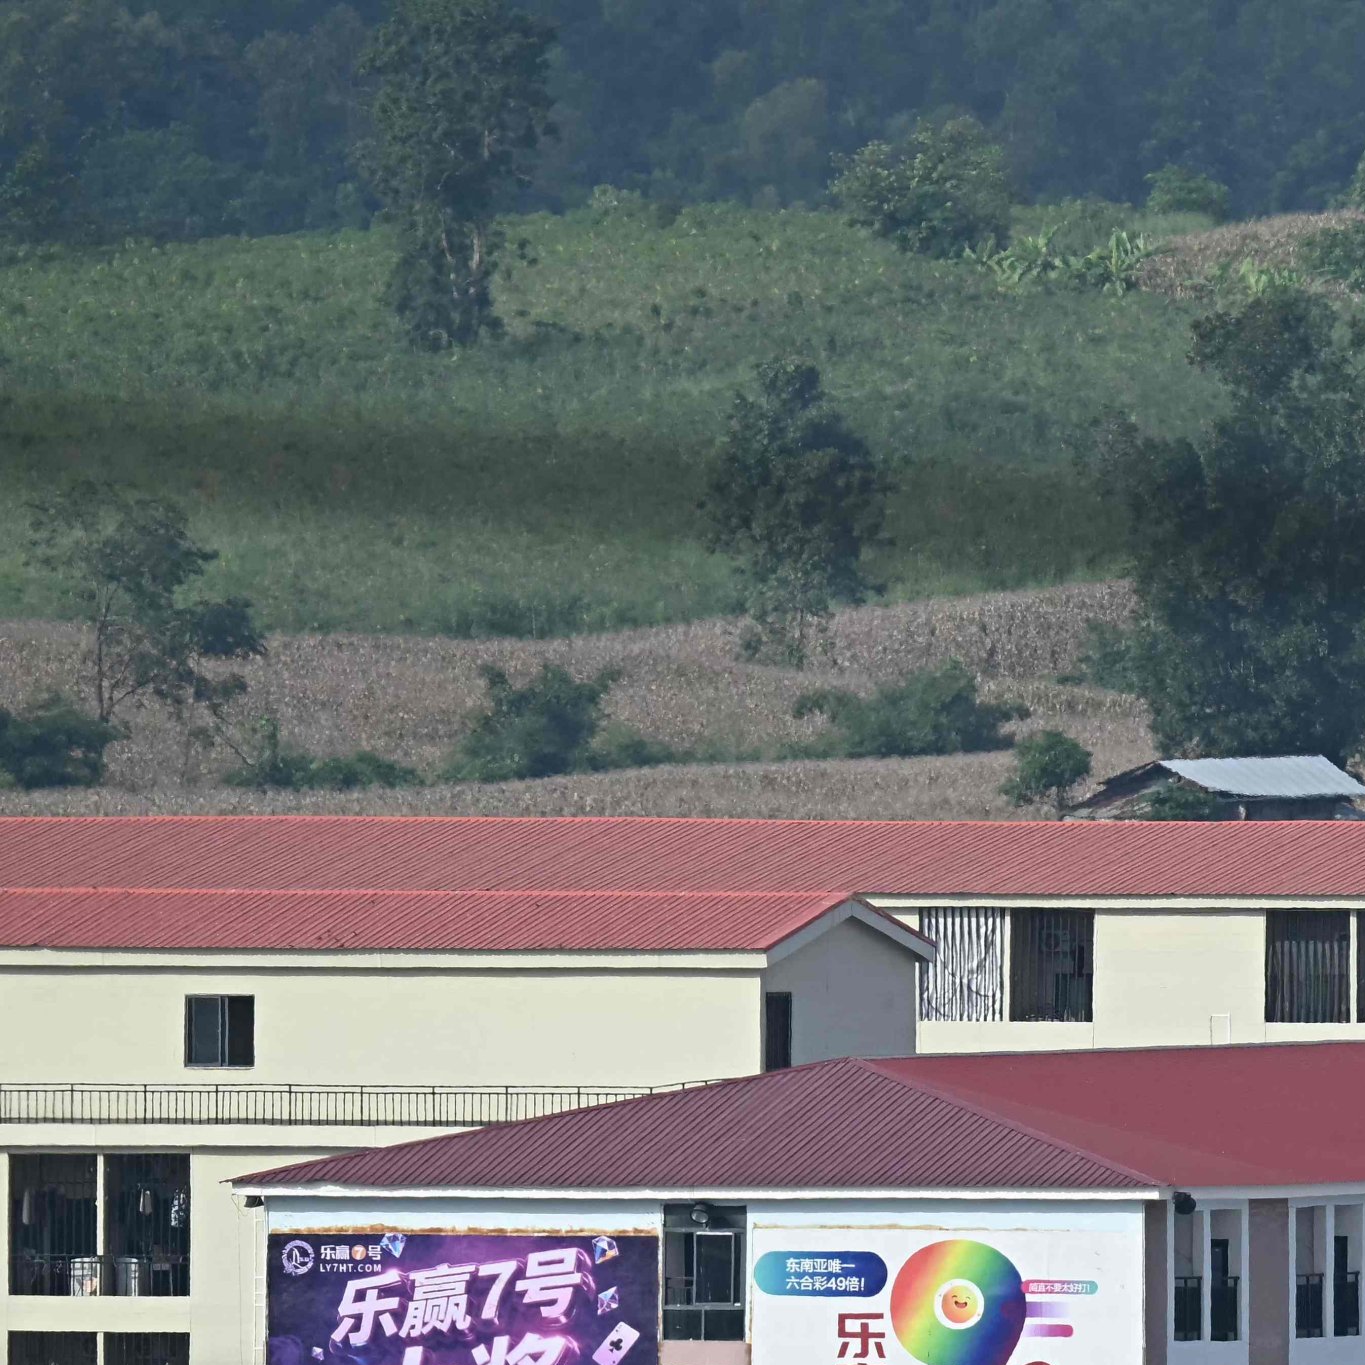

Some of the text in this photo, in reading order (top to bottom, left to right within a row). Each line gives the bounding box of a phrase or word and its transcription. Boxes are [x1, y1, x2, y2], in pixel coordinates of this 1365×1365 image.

[321, 1245, 382, 1260] 乐赢7号
[320, 1264, 382, 1272] LY7HT.COM
[786, 1258, 855, 1274] 东南亚唯一
[786, 1275, 865, 1292] 六合彩49倍!
[330, 1248, 583, 1345] 乐赢7号
